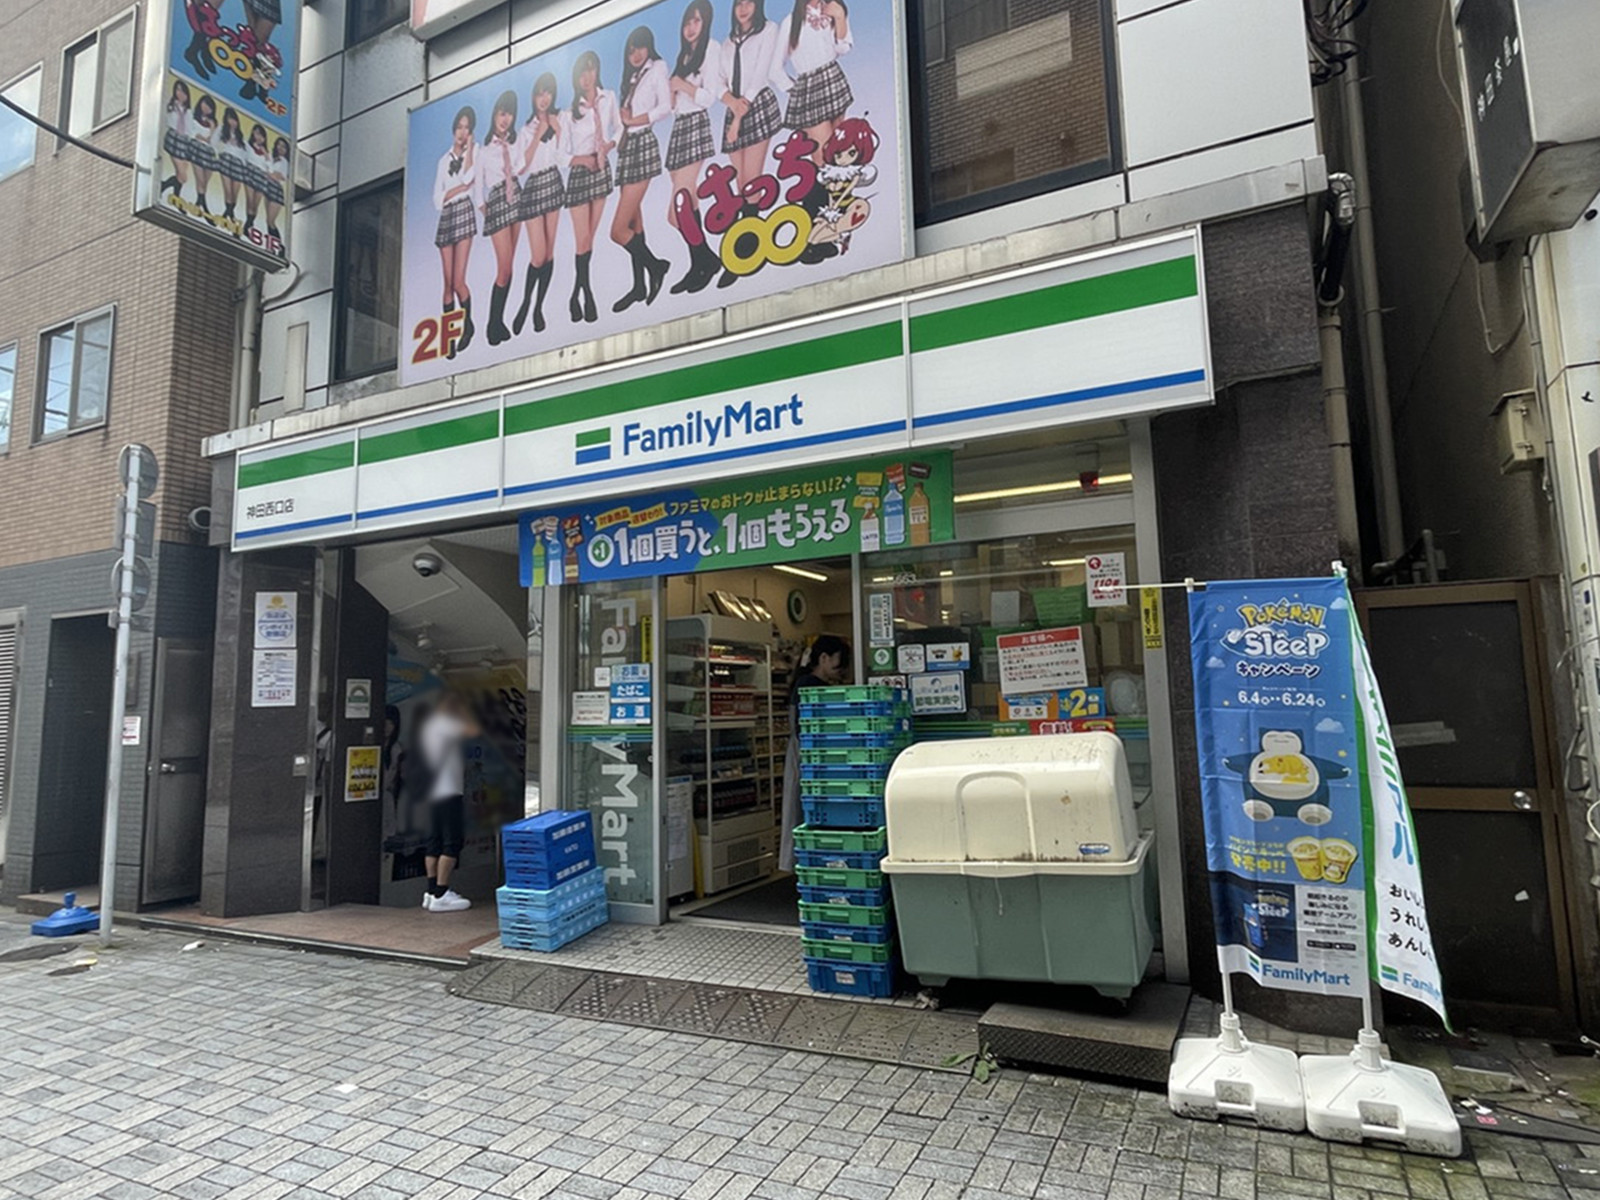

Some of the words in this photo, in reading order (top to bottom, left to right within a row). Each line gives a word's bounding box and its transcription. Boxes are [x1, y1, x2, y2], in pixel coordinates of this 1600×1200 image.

[265, 98, 288, 115] 2F
[412, 309, 466, 365] 2F
[623, 393, 804, 457] FamilyMart
[246, 498, 295, 520] 神田西口店
[1236, 661, 1320, 678] キャンペーン
[617, 684, 644, 697] たばこ
[591, 597, 638, 886] FayMart
[1262, 964, 1351, 986] FamilyMart
